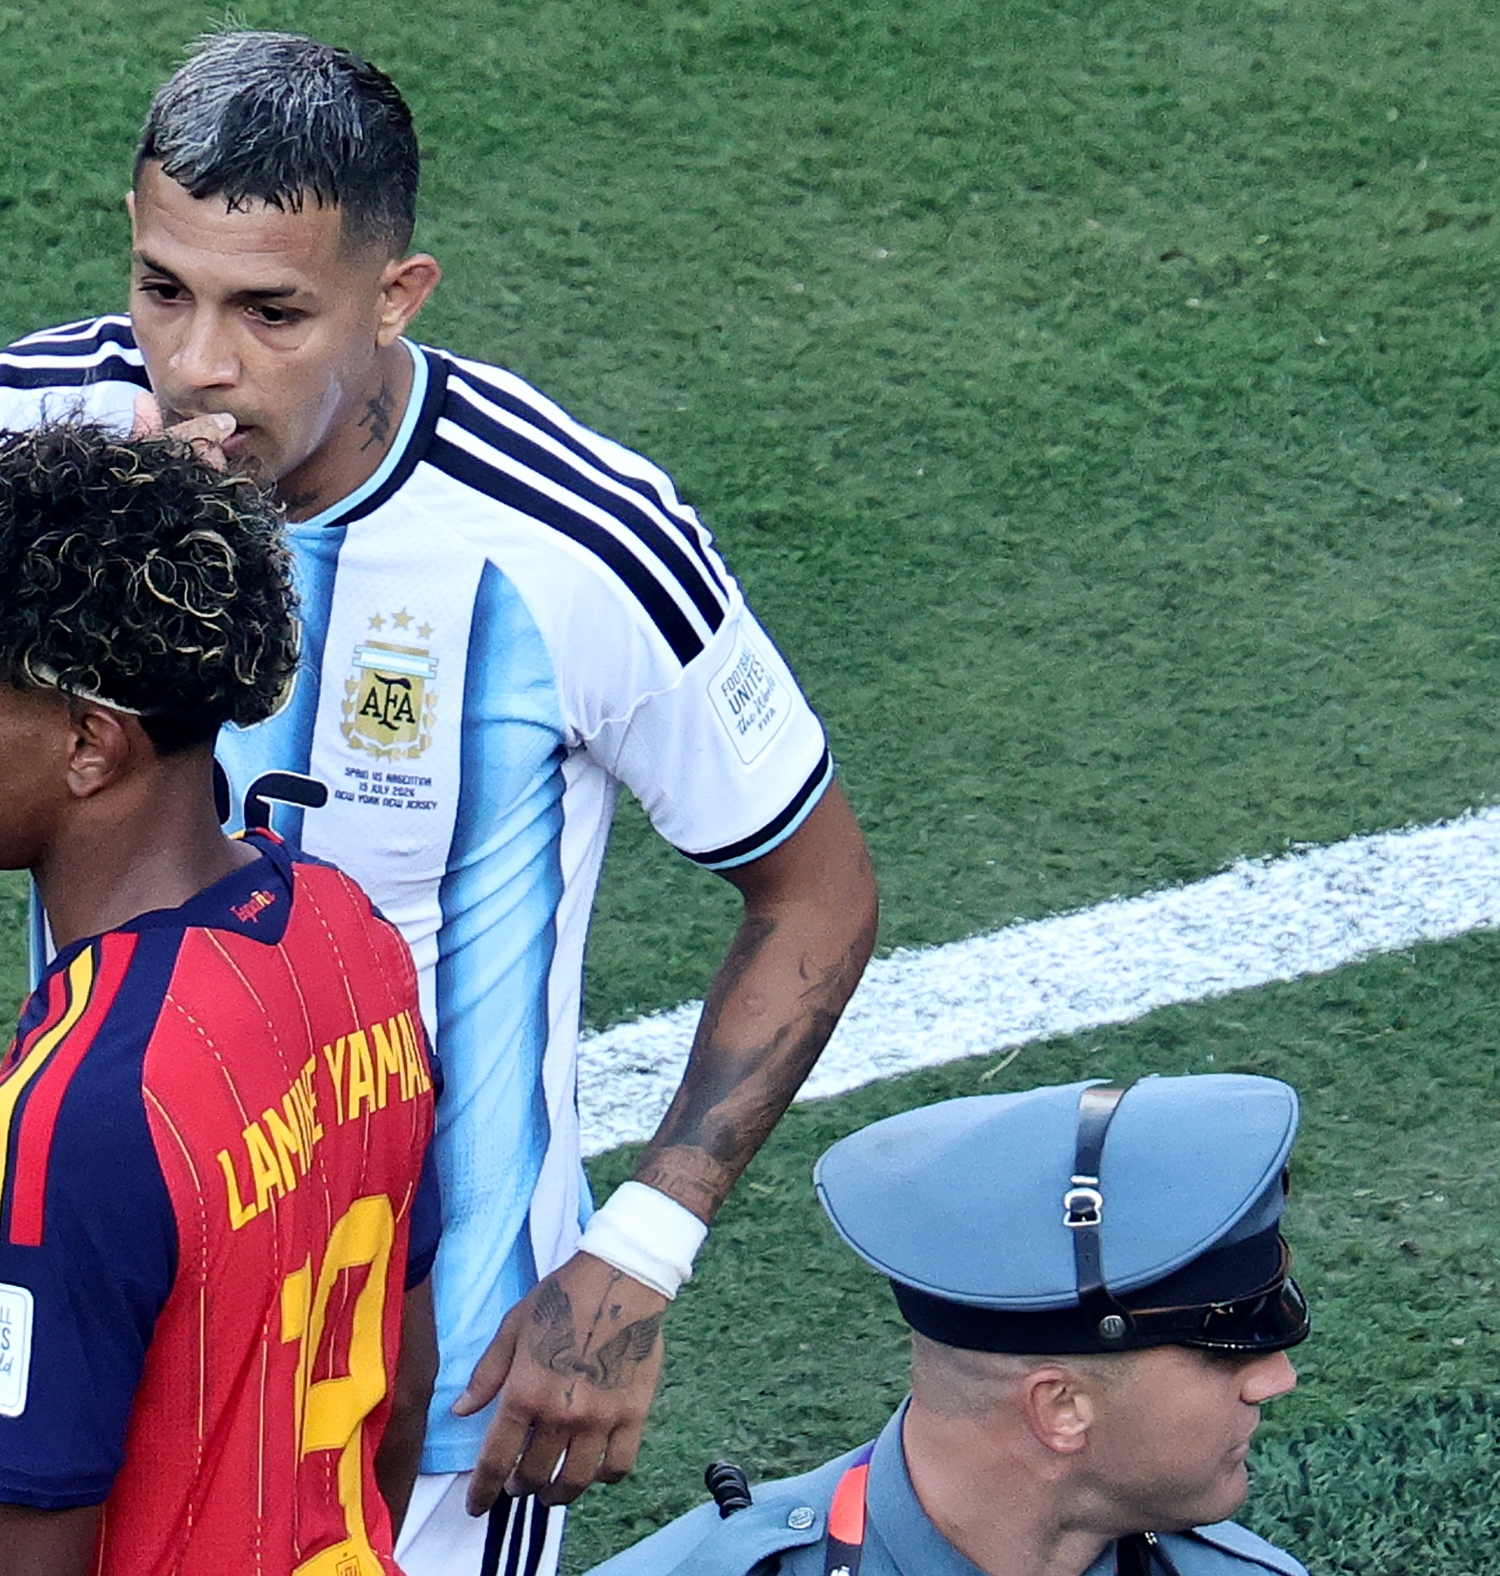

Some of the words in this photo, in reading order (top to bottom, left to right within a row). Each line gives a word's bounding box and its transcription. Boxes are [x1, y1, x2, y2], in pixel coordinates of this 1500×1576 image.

[359, 672, 416, 731] AFA
[728, 654, 765, 715] UNITES
[323, 1009, 432, 1126] YAMAL
